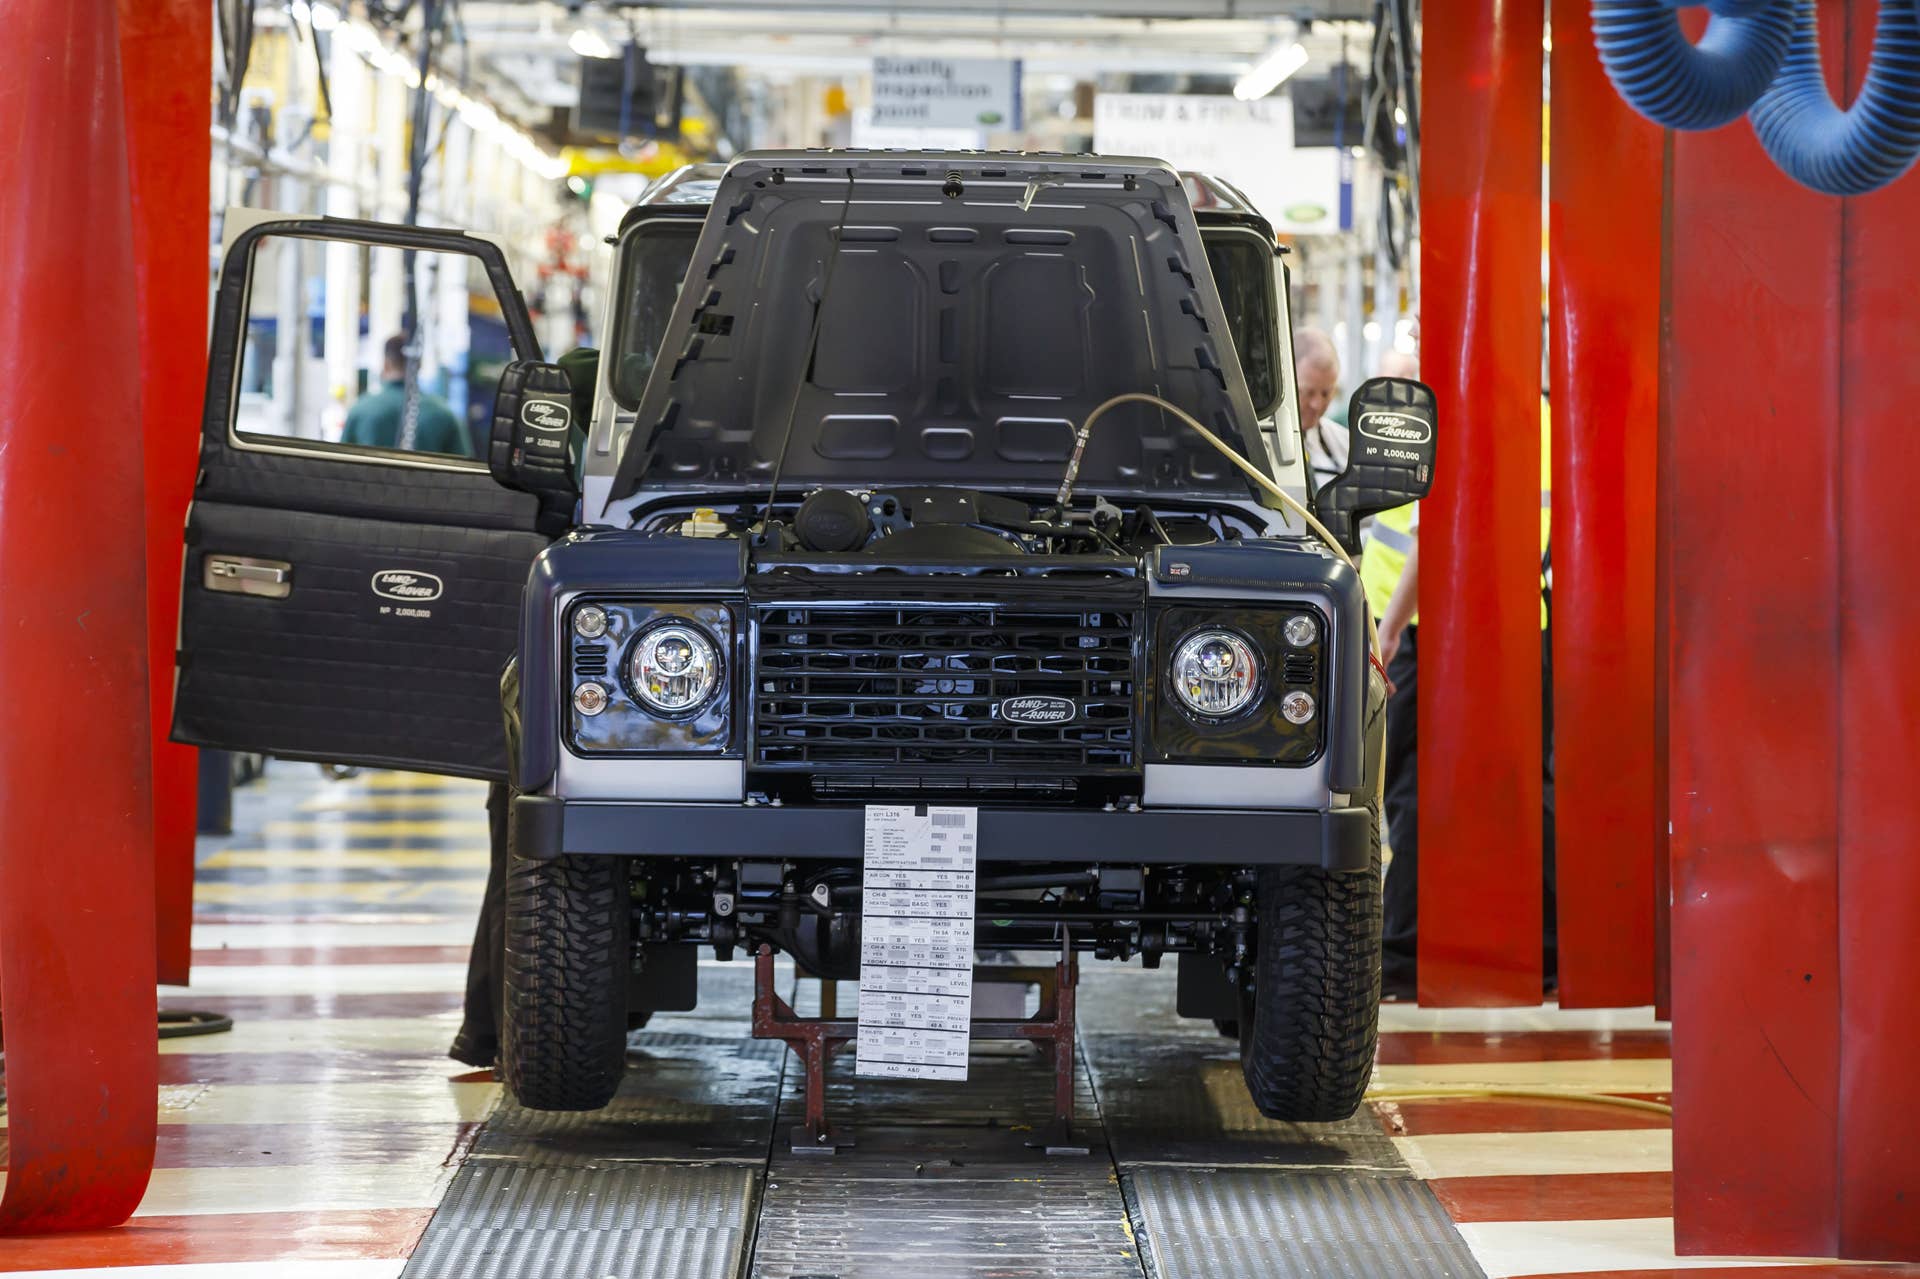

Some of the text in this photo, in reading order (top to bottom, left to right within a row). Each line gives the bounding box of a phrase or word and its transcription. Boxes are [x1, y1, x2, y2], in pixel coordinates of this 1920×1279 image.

[873, 57, 954, 79] Quality
[872, 104, 929, 125] point
[529, 403, 552, 414] LAND
[537, 415, 565, 427] ROVER
[1368, 415, 1402, 426] LAND
[1382, 426, 1422, 440] ROVER
[1383, 448, 1420, 461] 2,000,000
[381, 574, 414, 584] LAND
[394, 586, 433, 597] ROVER
[395, 607, 431, 618] 2,000,000
[1011, 700, 1043, 708] LAND
[1026, 710, 1066, 720] ROVER
